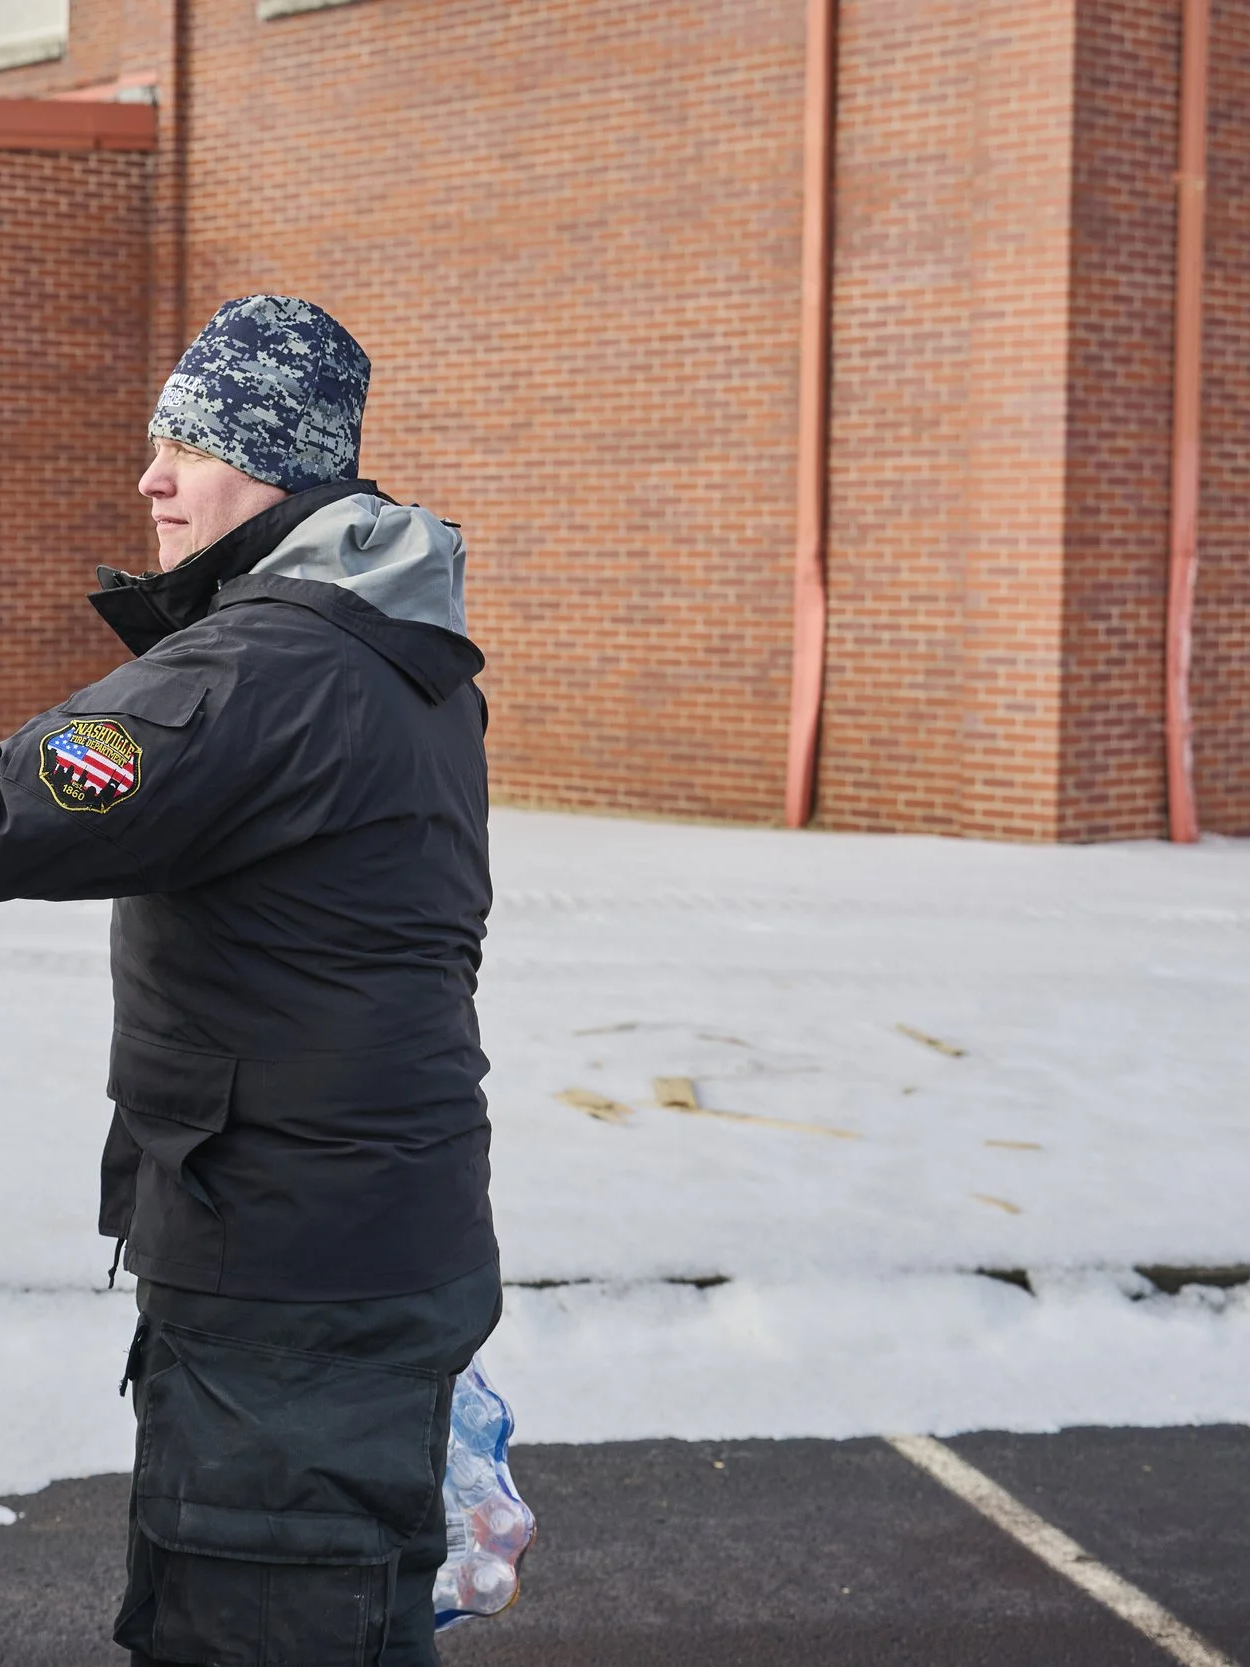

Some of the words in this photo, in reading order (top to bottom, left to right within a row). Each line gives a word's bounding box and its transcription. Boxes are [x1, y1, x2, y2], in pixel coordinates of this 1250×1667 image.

[70, 735, 86, 746] FIRE
[85, 740, 128, 767] DEPARTMENT
[74, 723, 135, 760] NASHVILLE
[62, 784, 85, 801] 1860
